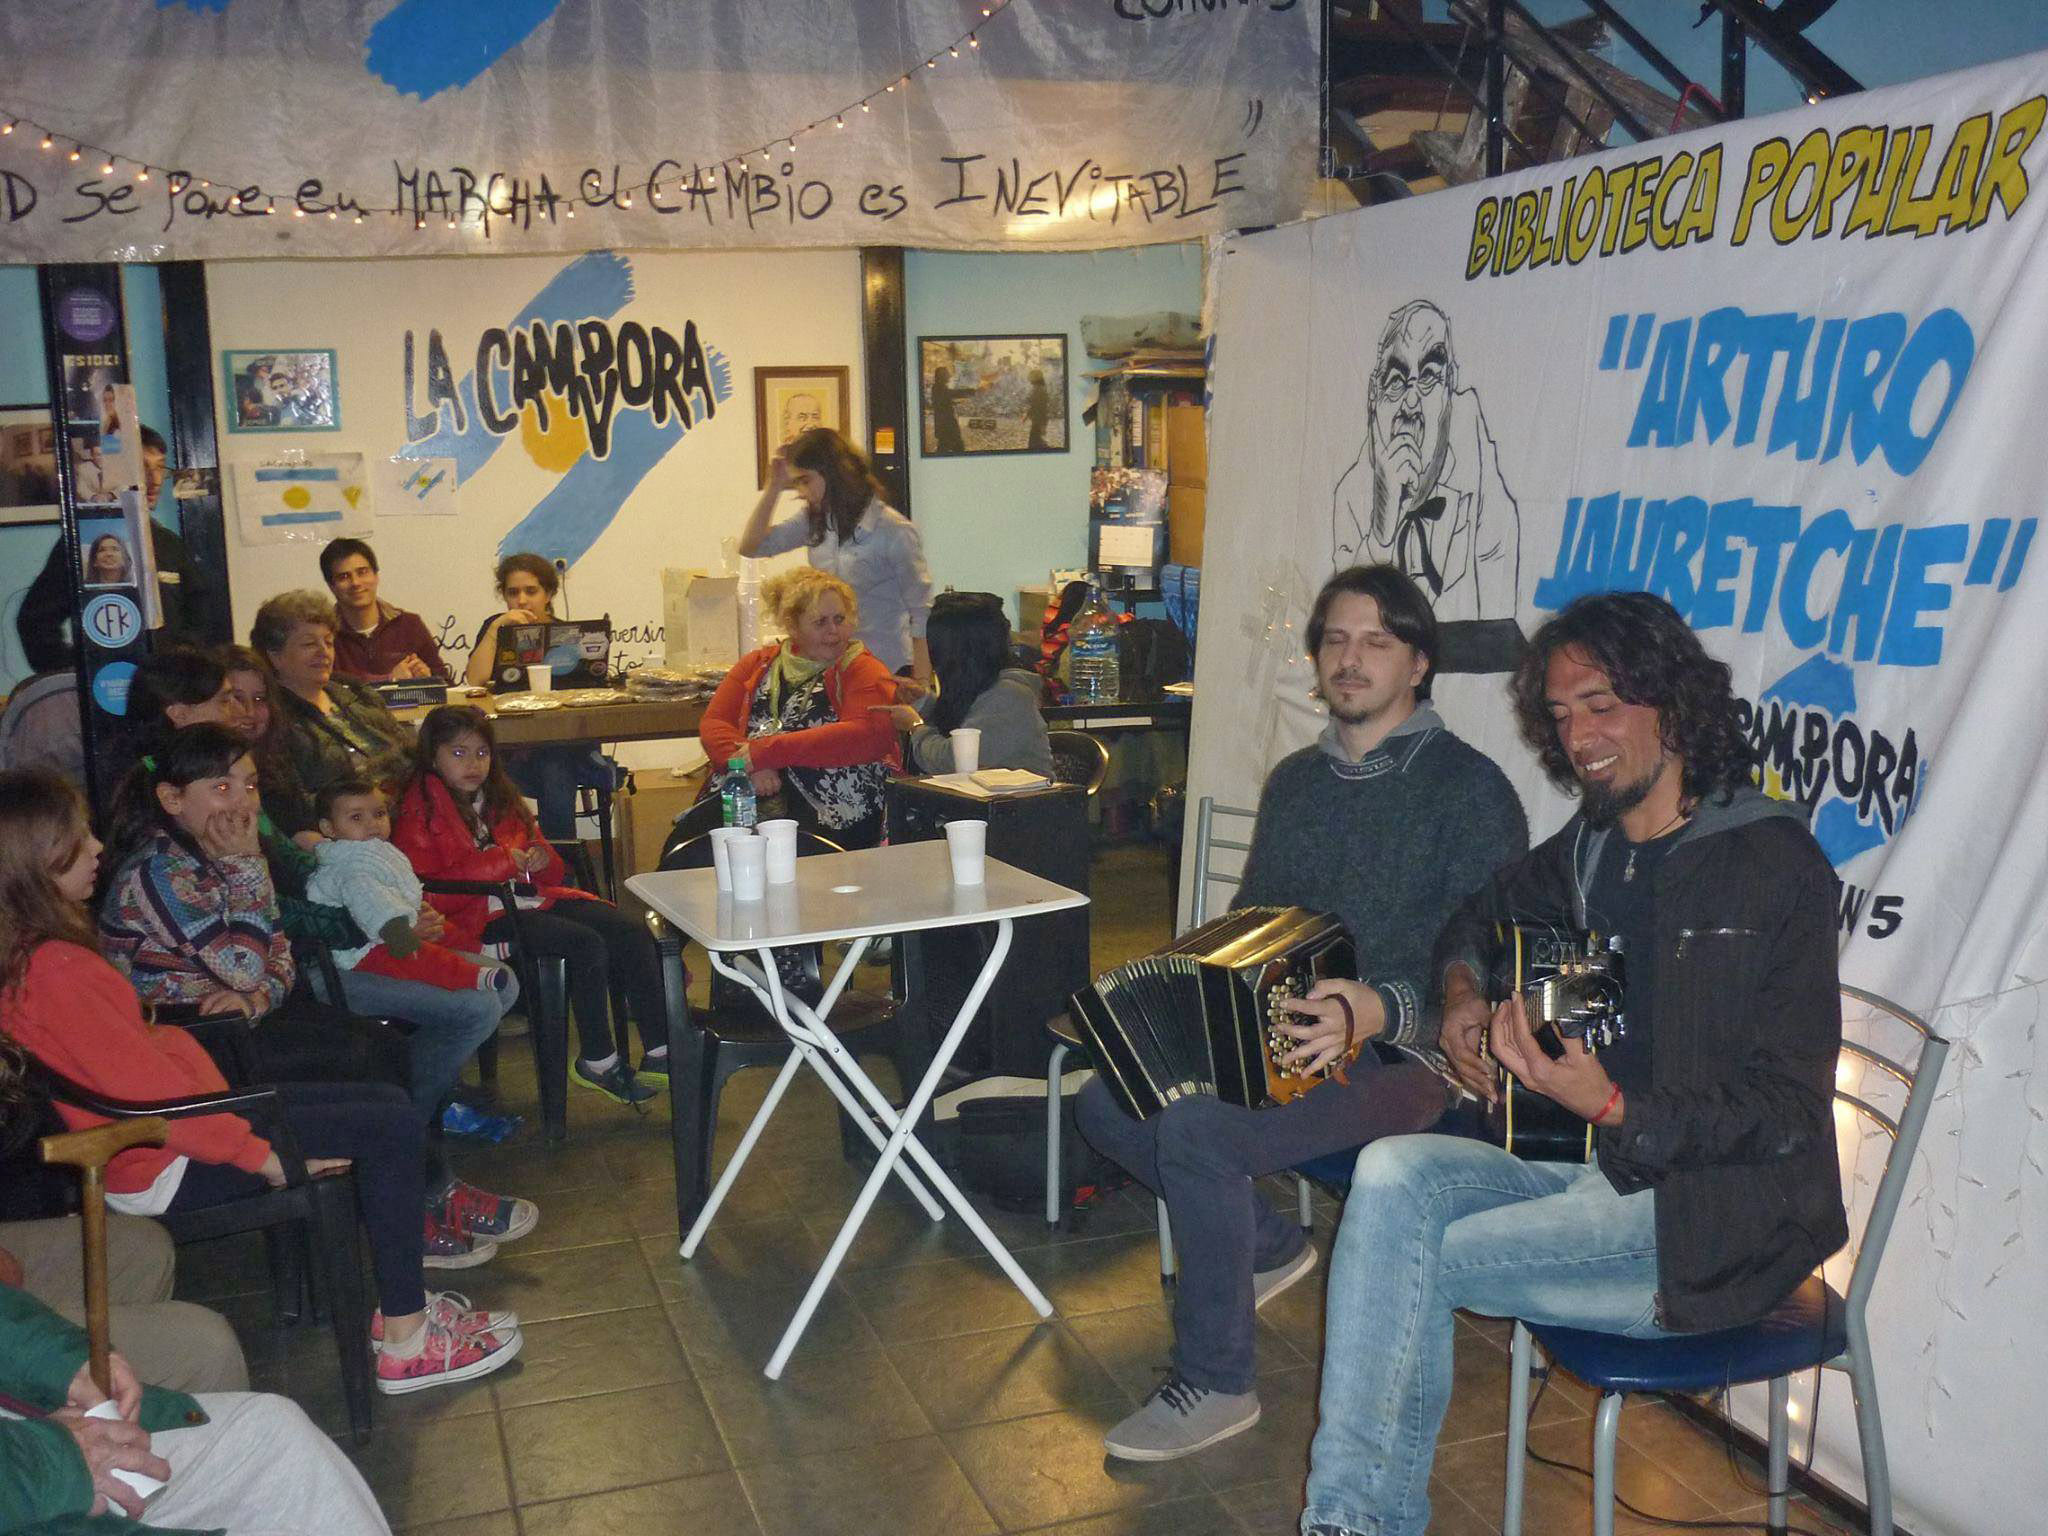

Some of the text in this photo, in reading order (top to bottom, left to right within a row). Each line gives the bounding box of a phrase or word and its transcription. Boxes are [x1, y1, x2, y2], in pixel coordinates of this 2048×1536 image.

[394, 160, 561, 238] MARCHA
[859, 183, 908, 222] es
[1465, 94, 2048, 281] BIBLIOTECA POPULAR
[404, 328, 466, 442] LA
[93, 604, 130, 637] CFK
[1867, 895, 1904, 940] 5
